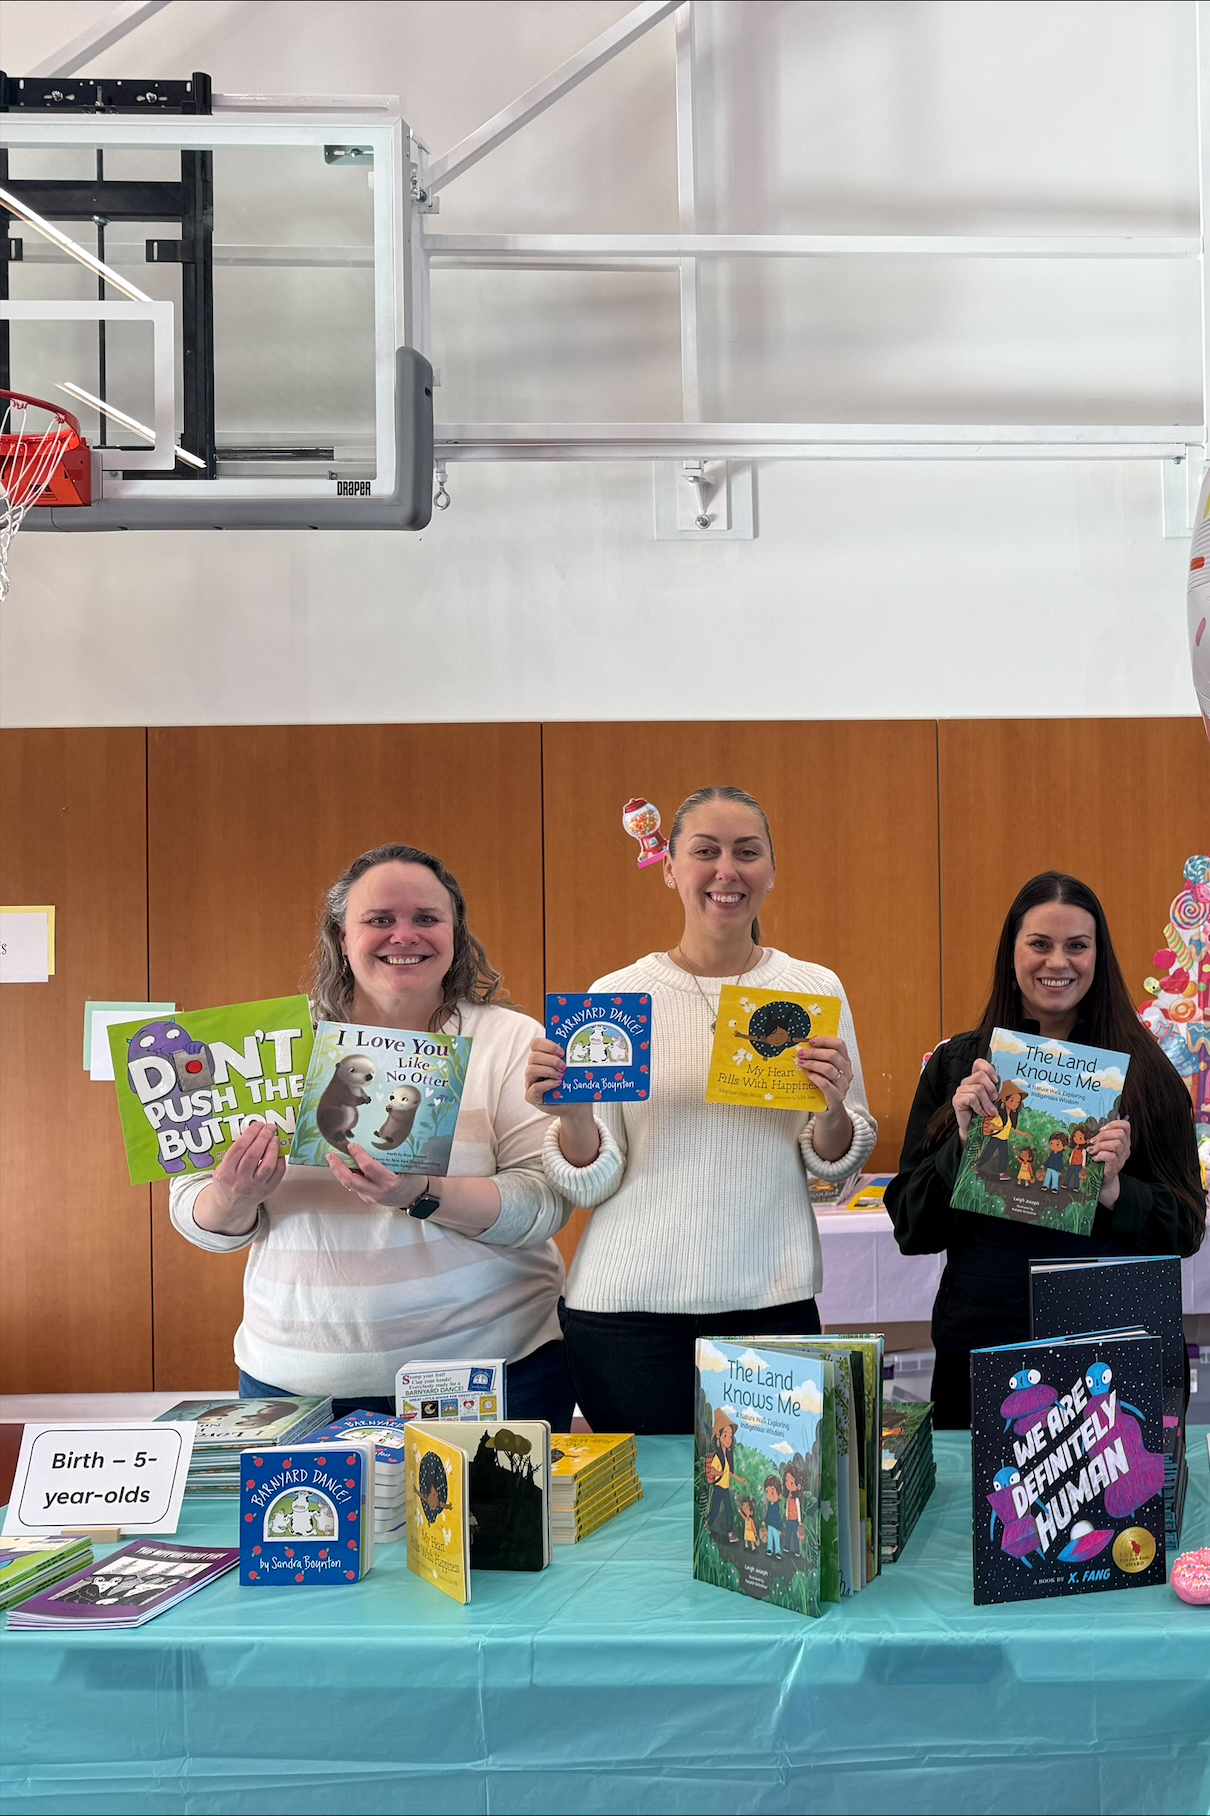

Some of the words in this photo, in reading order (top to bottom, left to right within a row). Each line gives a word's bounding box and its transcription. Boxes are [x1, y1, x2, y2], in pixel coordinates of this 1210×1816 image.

[555, 1007, 606, 1039] BARNYARD
[609, 1007, 644, 1037] DANCE!
[336, 1030, 347, 1046] I
[355, 1031, 405, 1052] Love
[412, 1038, 449, 1057] You
[398, 1057, 430, 1071] Like
[1026, 1045, 1053, 1065] The
[1057, 1052, 1098, 1074] Land
[386, 1071, 406, 1083] No
[410, 1072, 449, 1088] Otter
[746, 1064, 764, 1079] My
[767, 1067, 795, 1077] Heart
[1016, 1062, 1072, 1086] Knows
[1076, 1073, 1101, 1092] Me
[562, 1080, 571, 1093] by
[573, 1078, 600, 1090] Sandra
[600, 1077, 635, 1092] Boynton
[717, 1073, 739, 1086] Fills
[742, 1077, 768, 1089] With
[771, 1079, 820, 1093] Happines
[1031, 1085, 1049, 1093] Nature
[1062, 1091, 1086, 1101] Exploring
[143, 1086, 239, 1130] PUSH
[245, 1074, 305, 1104] THE
[1059, 1097, 1079, 1105] Wisdom
[157, 1105, 301, 1162] BUTTON
[727, 1359, 753, 1383] The
[757, 1365, 794, 1391] Land
[405, 1388, 439, 1396] BARNYARD
[723, 1382, 773, 1411] Knows
[777, 1393, 801, 1417] Me
[739, 1413, 756, 1422] Nature
[767, 1418, 790, 1431] Exploring
[740, 1422, 765, 1434] Indigenous
[765, 1427, 785, 1438] Wisdom
[1013, 1421, 1048, 1468] WE
[1046, 1377, 1088, 1440] ARE
[52, 1451, 104, 1469] Birth
[1011, 1389, 1117, 1519] DEFINITELY
[42, 1485, 151, 1510] year-olds
[251, 1469, 308, 1507] BARNYARD
[312, 1469, 352, 1504] DANCE!
[1035, 1436, 1130, 1553] HUMAN
[259, 1558, 270, 1572] by
[271, 1556, 302, 1570] Sandra
[303, 1555, 341, 1572] Boynton
[1038, 1577, 1056, 1585] BOOK
[1067, 1572, 1079, 1584] X.
[1082, 1568, 1111, 1583] FANG
